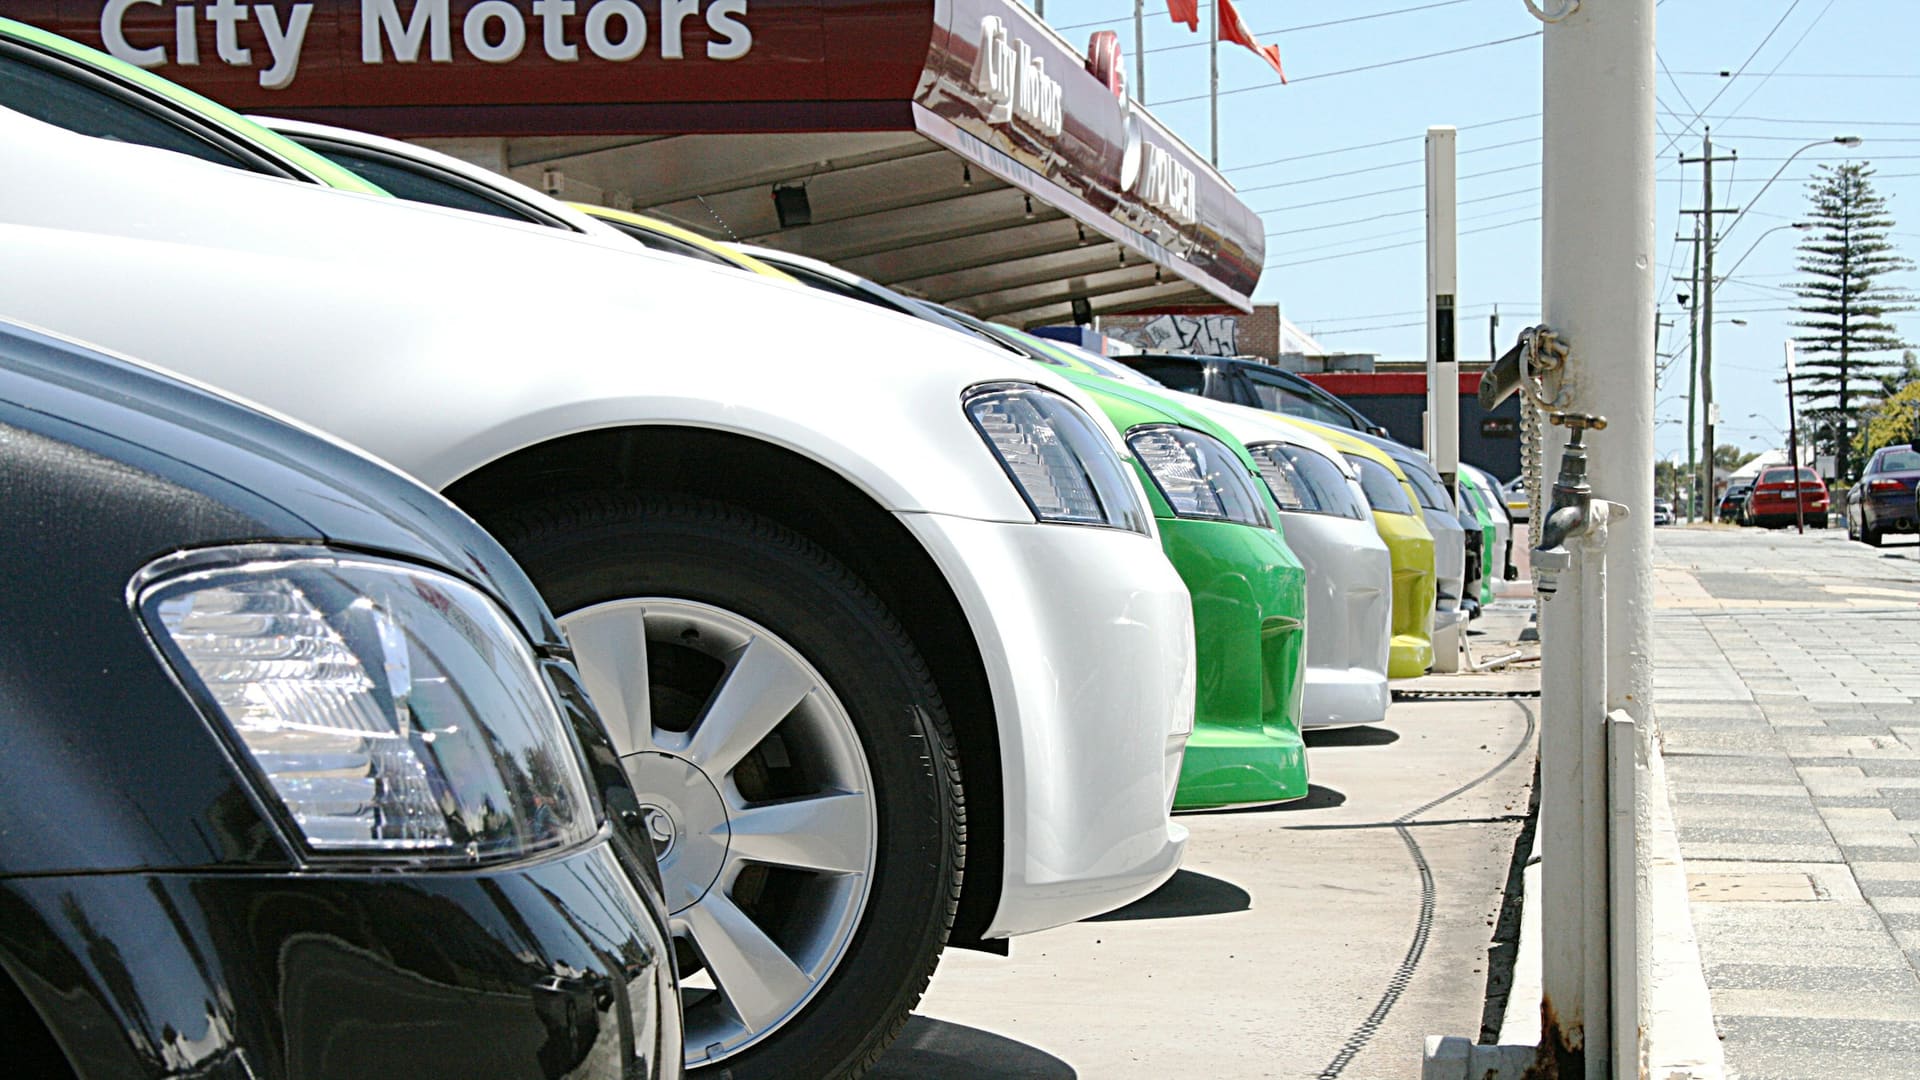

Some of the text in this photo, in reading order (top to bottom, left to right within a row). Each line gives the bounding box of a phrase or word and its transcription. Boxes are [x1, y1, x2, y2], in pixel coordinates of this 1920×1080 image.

[100, 0, 753, 89] City Motors
[979, 14, 1062, 136] City Motors
[1144, 143, 1196, 223] HOLDEN
